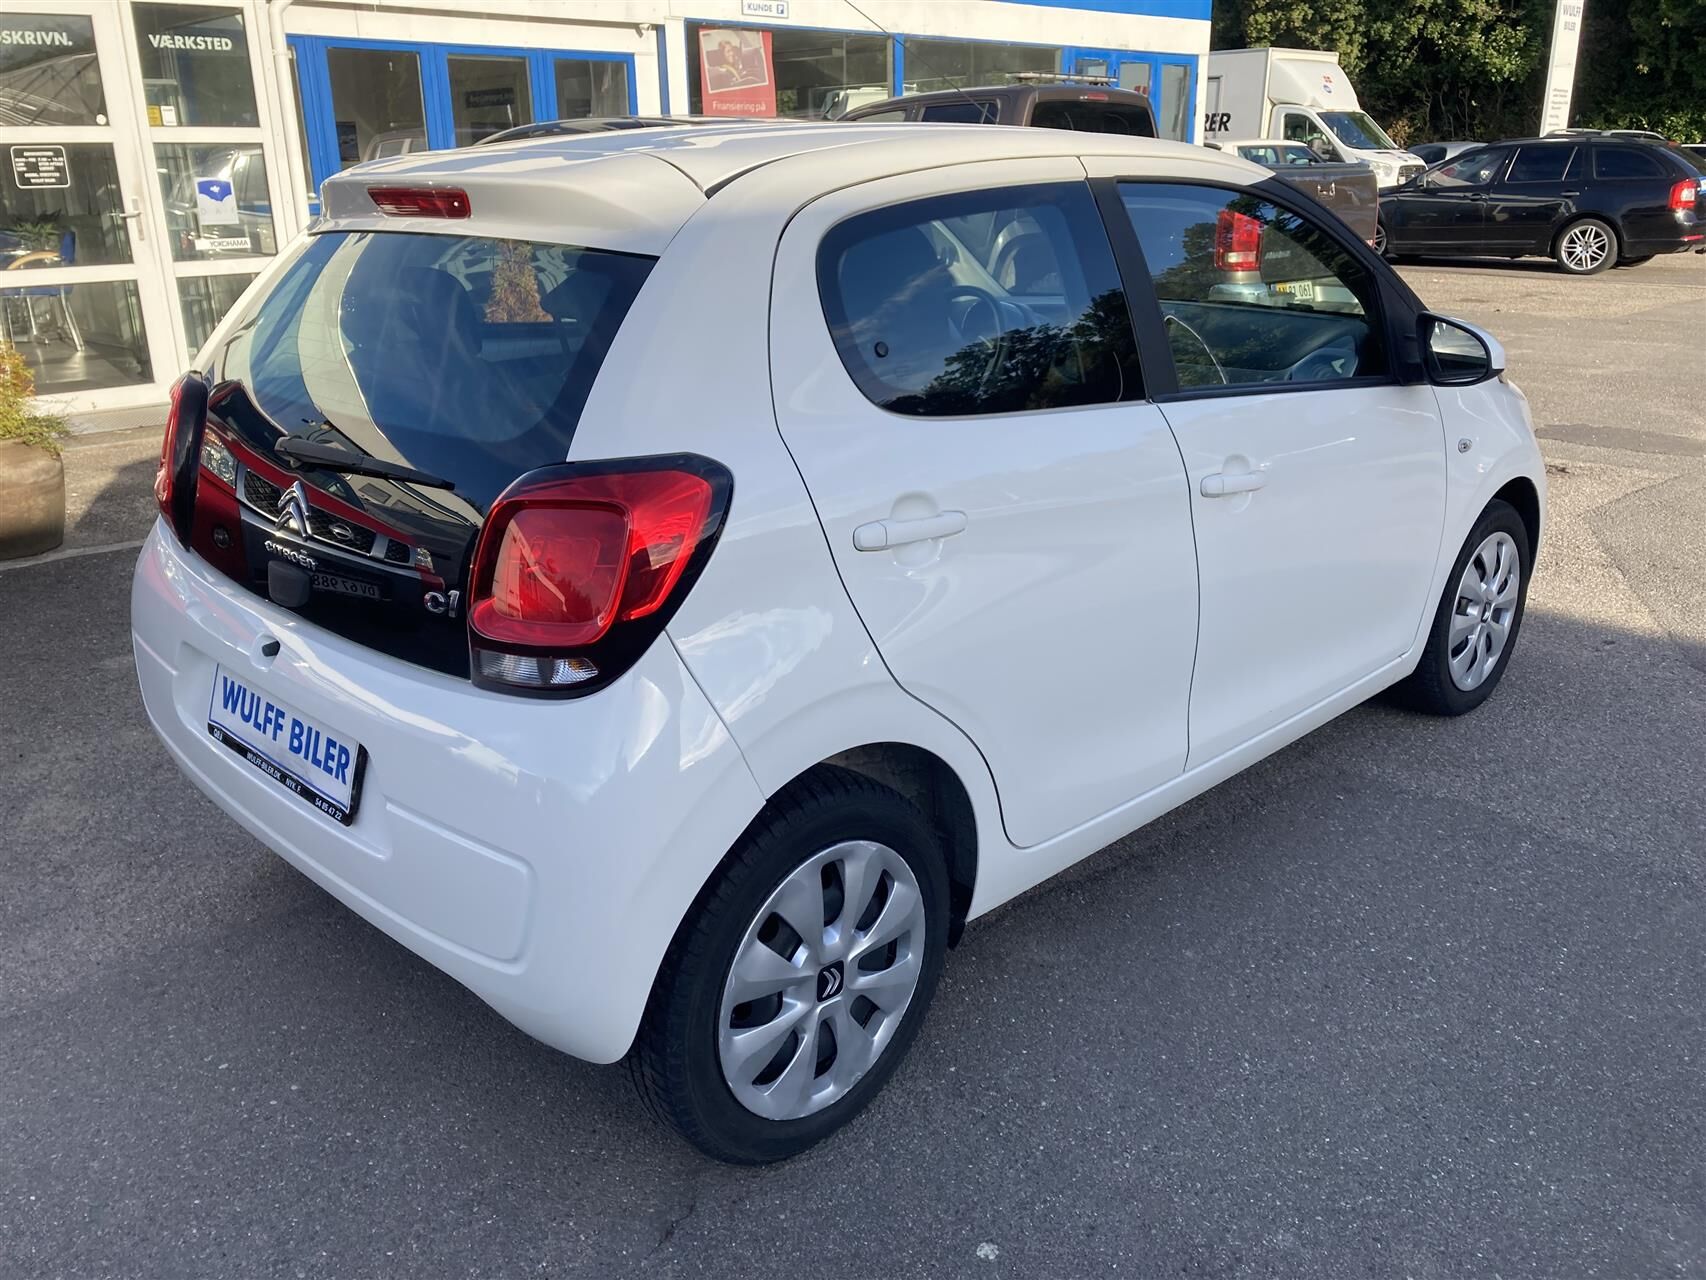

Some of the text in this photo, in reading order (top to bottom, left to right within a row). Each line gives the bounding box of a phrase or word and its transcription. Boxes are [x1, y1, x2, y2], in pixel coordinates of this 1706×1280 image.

[747, 3, 773, 12] KUNDE
[0, 30, 73, 46] SKRIVN.
[149, 34, 233, 51] VÆRKSTED
[712, 100, 755, 112] Finansiering
[209, 239, 249, 248] YOKOHAMA
[264, 540, 317, 571] CITROËN
[423, 589, 460, 618] C1
[222, 675, 351, 785] WULFF BILER
